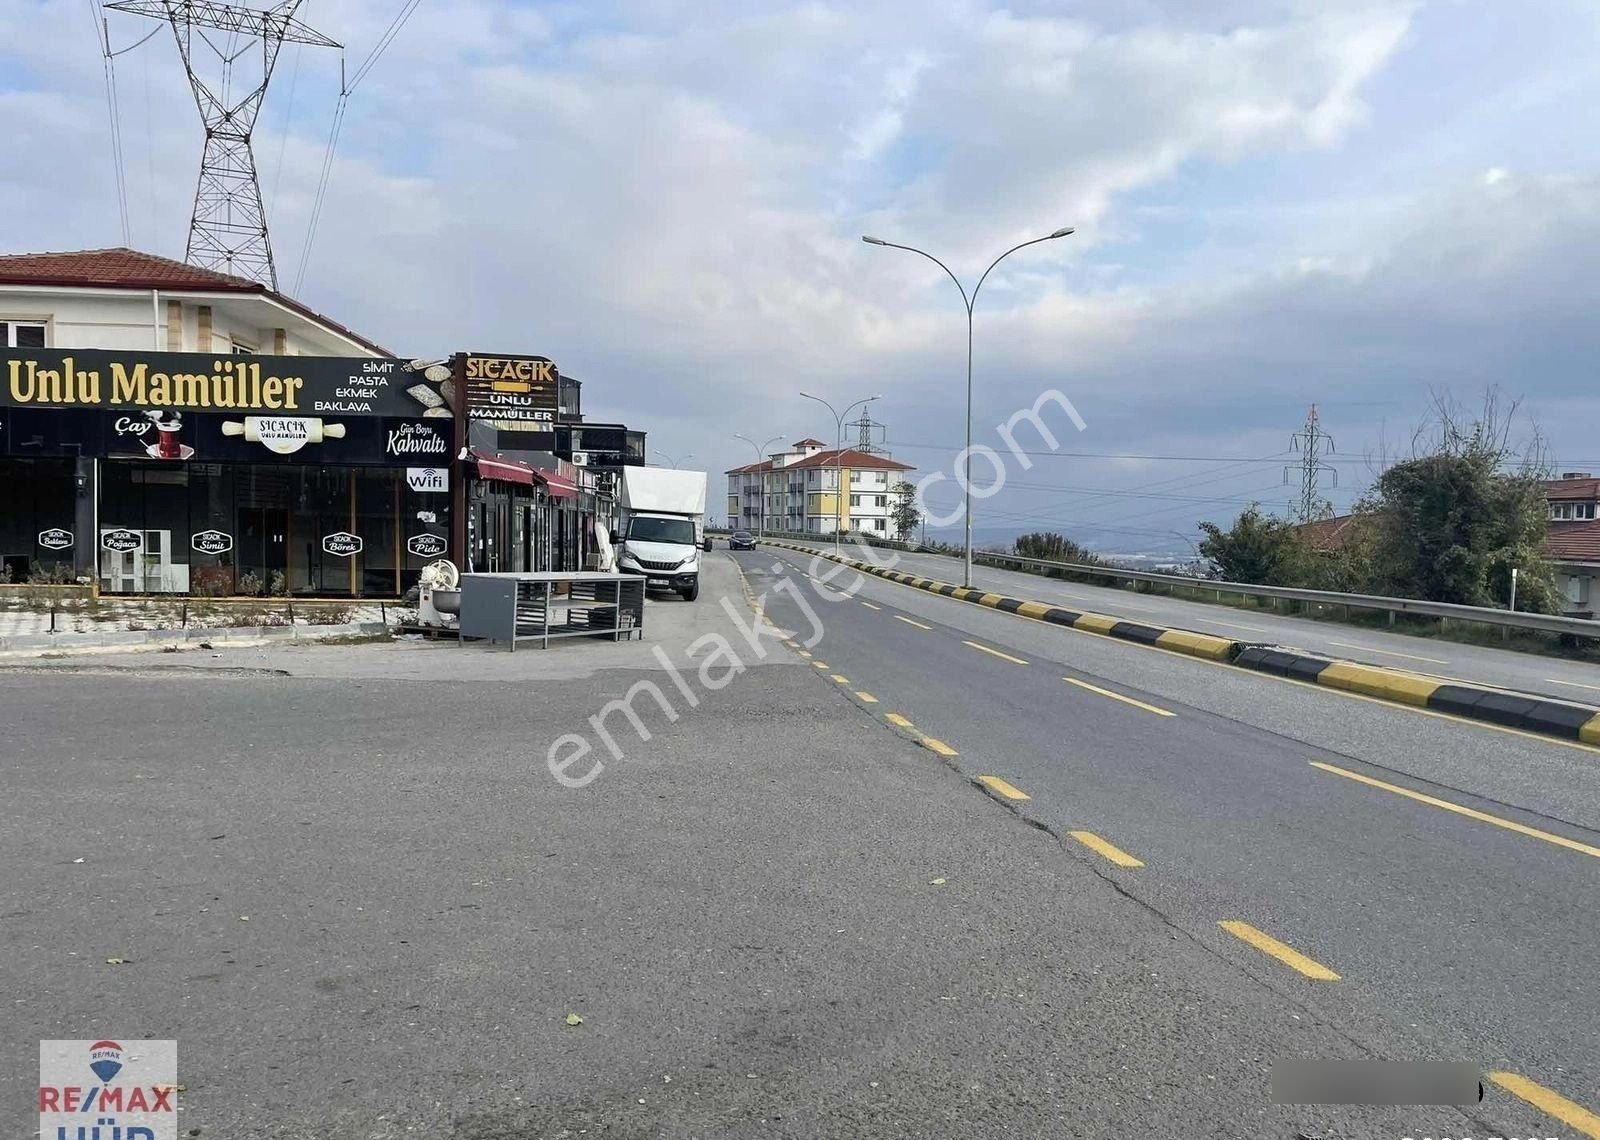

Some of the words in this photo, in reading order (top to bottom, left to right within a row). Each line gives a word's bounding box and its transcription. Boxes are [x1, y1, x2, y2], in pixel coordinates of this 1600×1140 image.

[363, 361, 395, 373] SİMİT
[7, 357, 101, 403] Unlu
[109, 360, 303, 409] Mamüller
[349, 375, 389, 386] PASTA
[335, 388, 378, 399] EKMEK
[490, 394, 531, 405] UNLU
[314, 401, 372, 412] BAKLAVA
[469, 407, 553, 421] MAMÜLLER
[114, 416, 152, 436] Çay
[400, 423, 415, 436] Gün
[415, 423, 433, 436] Boyu
[386, 430, 447, 456] Kahvaltı
[409, 476, 442, 488] Wifi
[199, 541, 226, 550] Simit
[328, 542, 357, 551] Börek
[414, 543, 441, 553] Pide
